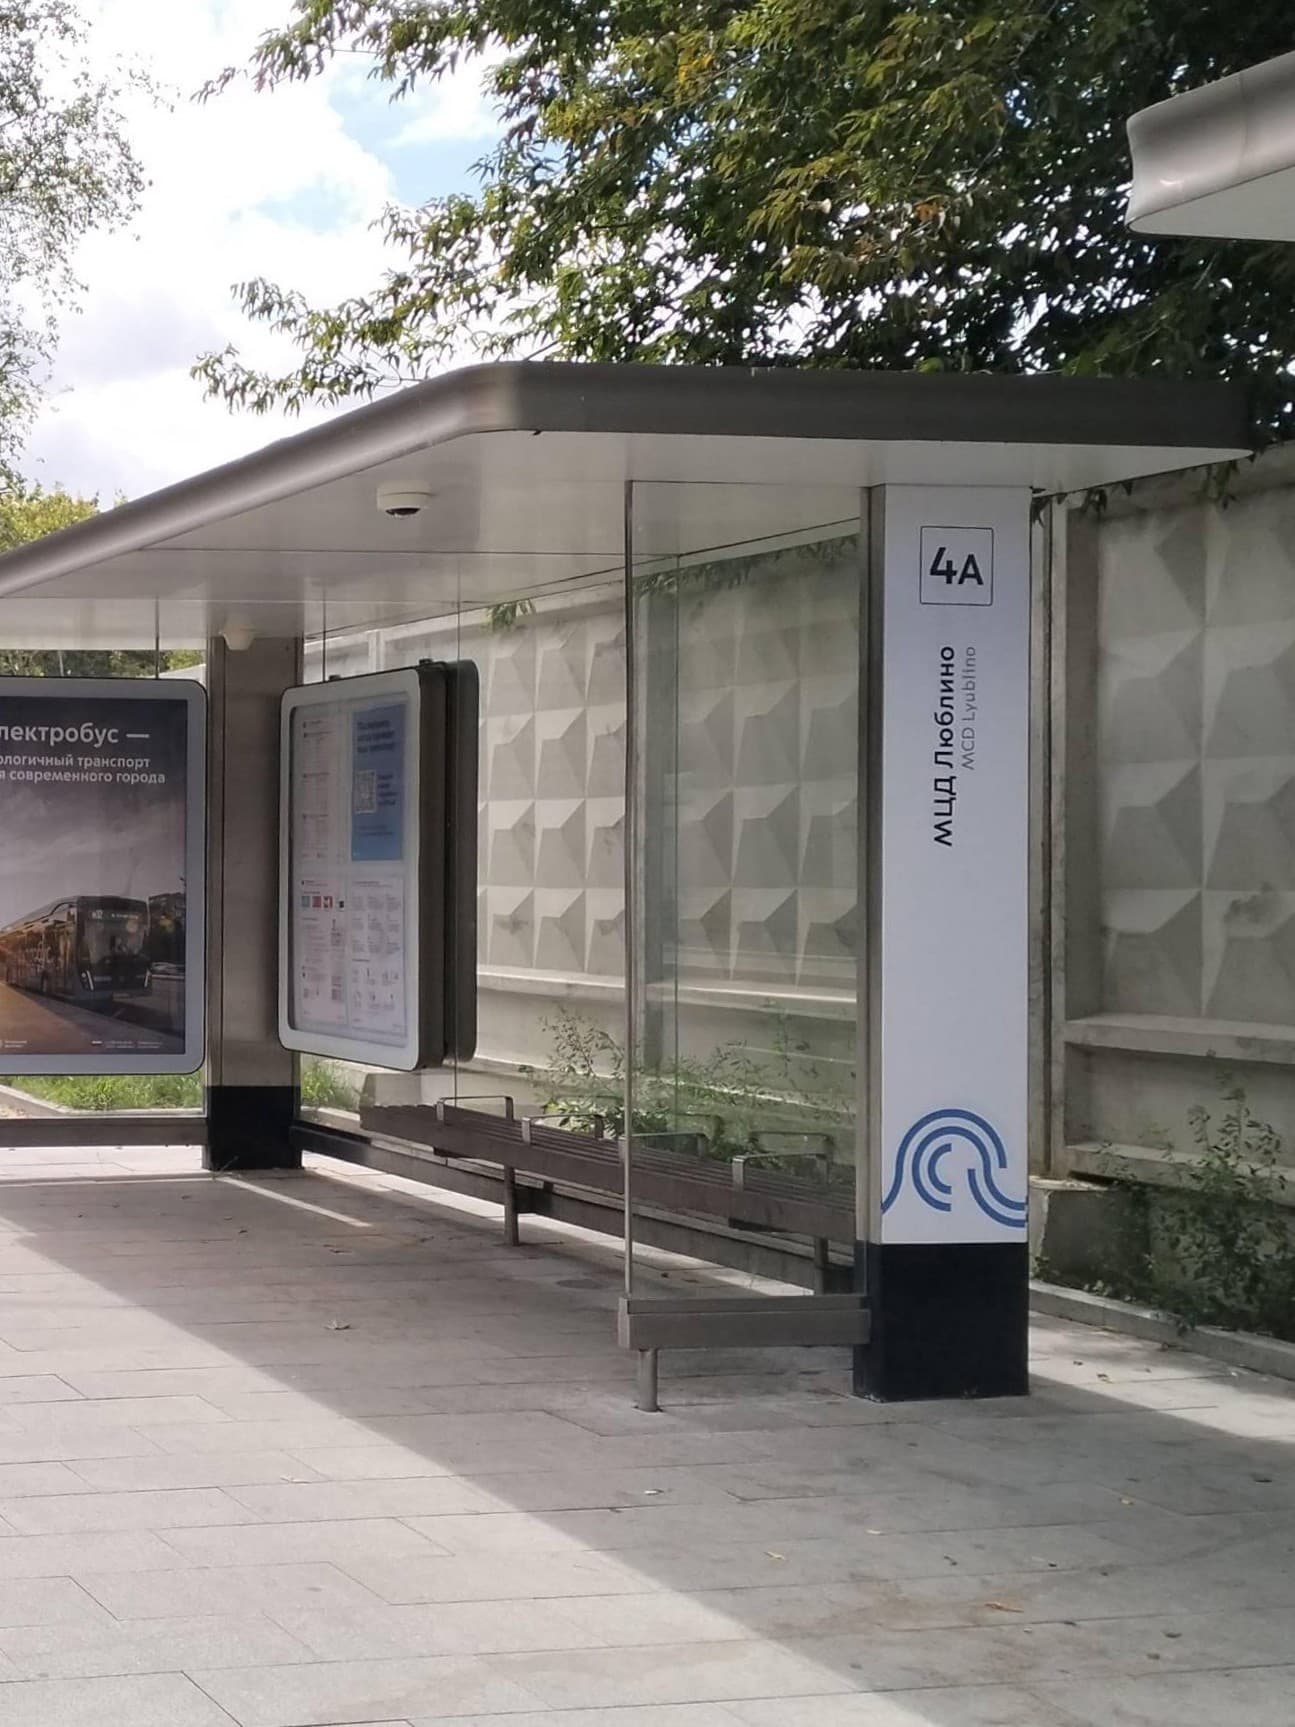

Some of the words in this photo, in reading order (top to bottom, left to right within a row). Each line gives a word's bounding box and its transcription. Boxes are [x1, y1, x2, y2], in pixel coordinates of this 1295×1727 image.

[933, 646, 956, 769] Люблино
[961, 646, 977, 721] Lyublino
[9, 770, 113, 784] современного
[116, 772, 166, 785] города
[77, 756, 151, 770] транспорт
[960, 726, 976, 771] MCD
[933, 775, 957, 847] МЦД
